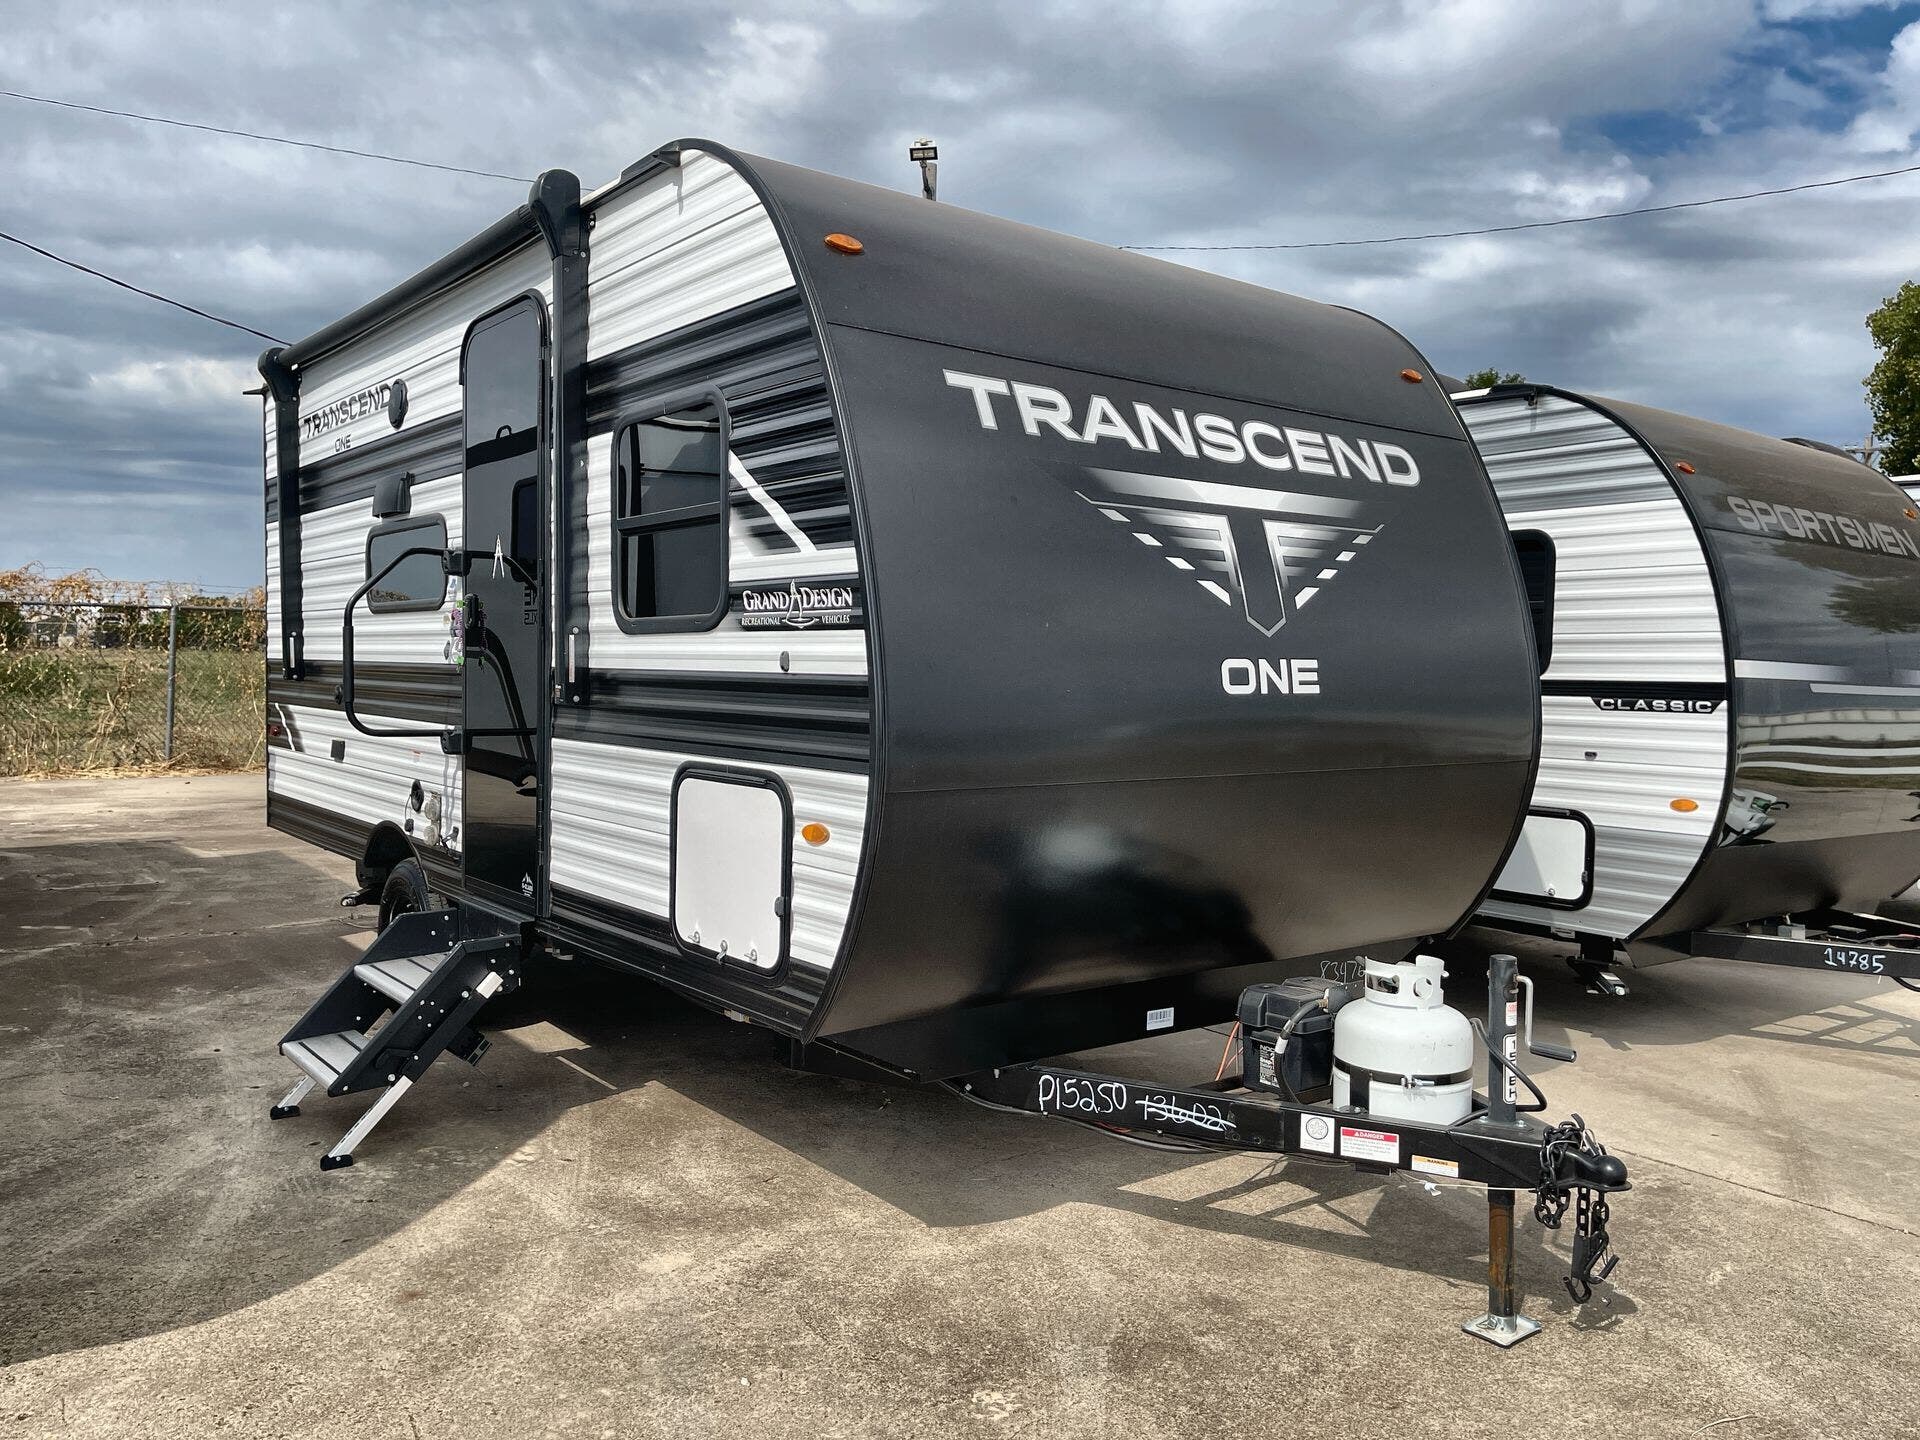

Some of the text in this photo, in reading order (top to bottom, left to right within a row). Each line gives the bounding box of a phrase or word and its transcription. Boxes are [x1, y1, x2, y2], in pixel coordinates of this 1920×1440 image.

[303, 383, 393, 439] TRANSCEND
[942, 368, 1422, 488] TRANSCEND
[334, 433, 352, 453] ONE
[1727, 496, 1920, 558] SPORTSMEN
[742, 587, 853, 611] GRAND DESIGN
[741, 614, 851, 626] RECREATIONAL VEHICLES
[1220, 657, 1321, 695] ONE
[1599, 698, 1713, 713] CLASSIC
[1823, 946, 1887, 974] 14785
[1038, 1074, 1127, 1114] P15250
[1359, 1131, 1385, 1141] DANGER
